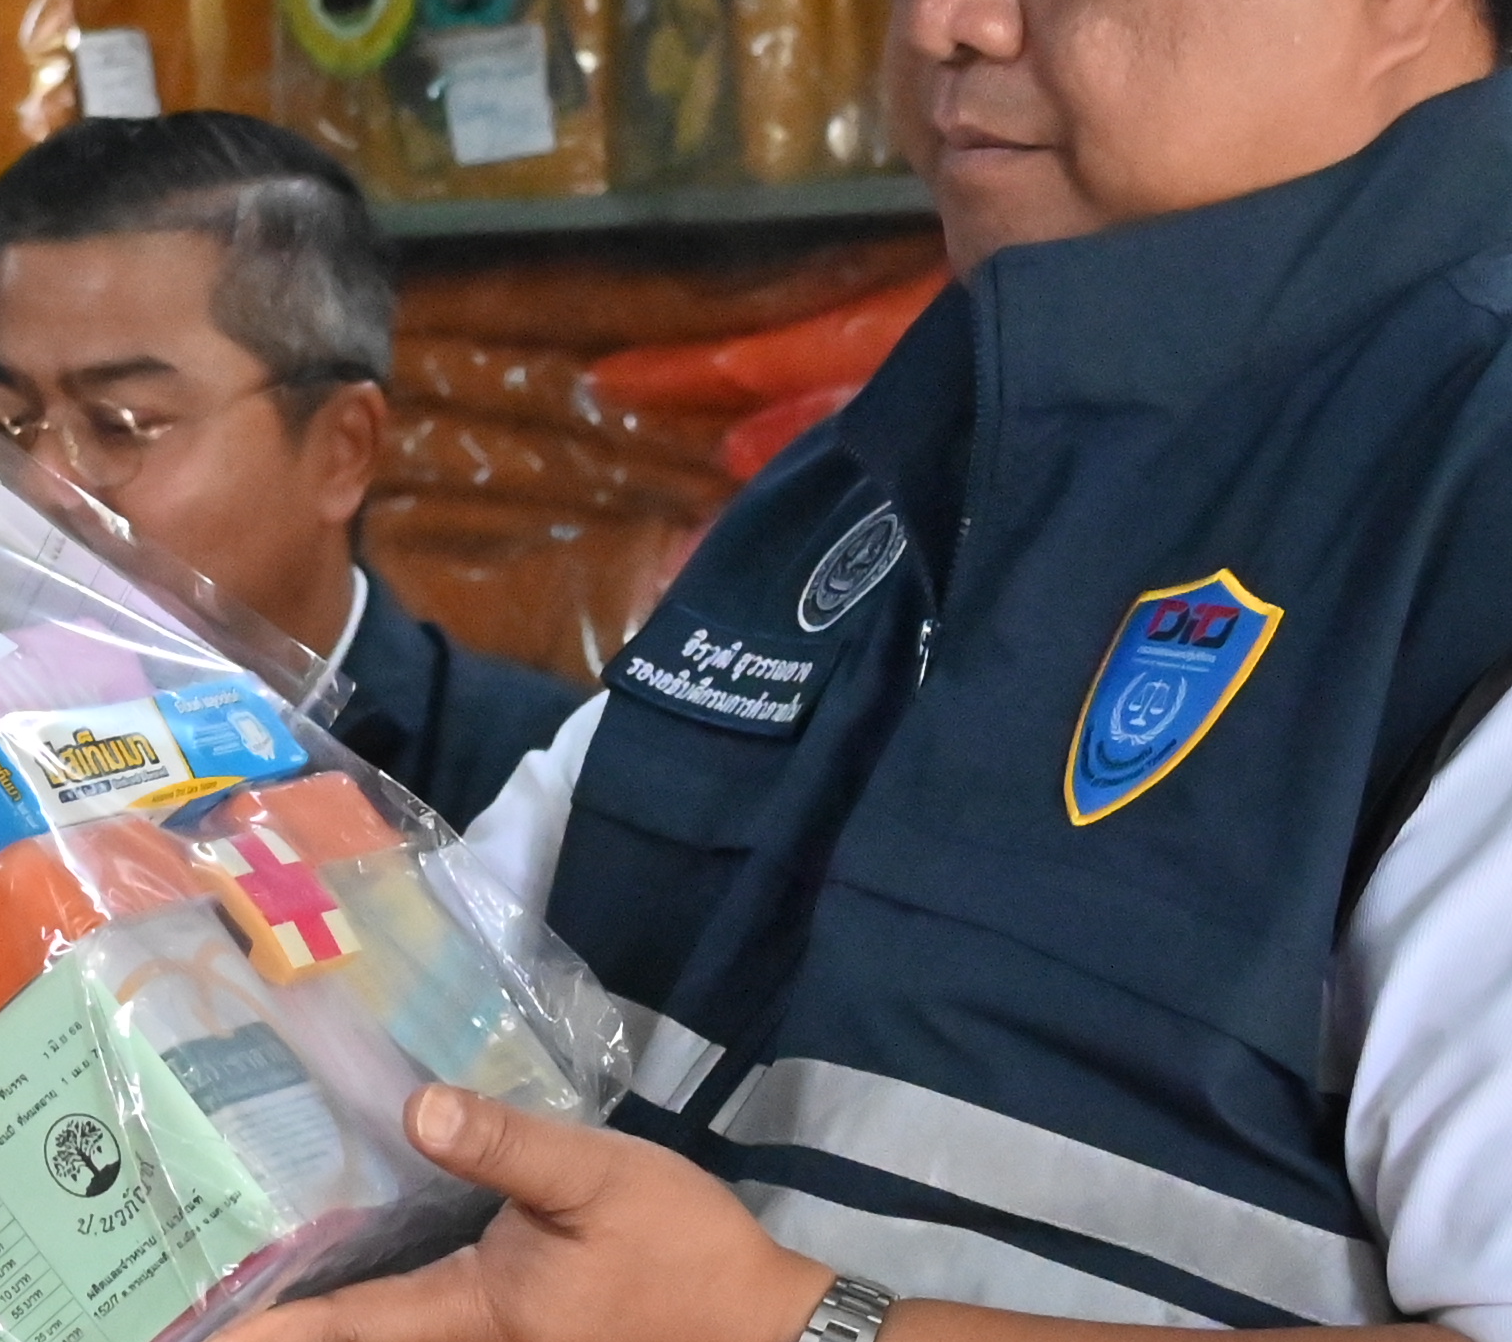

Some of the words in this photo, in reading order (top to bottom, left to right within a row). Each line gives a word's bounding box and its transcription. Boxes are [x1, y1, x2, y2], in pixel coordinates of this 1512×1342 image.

[0, 1289, 13, 1303] 10
[10, 1273, 32, 1294] บาท
[10, 1305, 25, 1320] 55
[22, 1289, 44, 1310] บาท
[93, 1293, 119, 1318] 152/7
